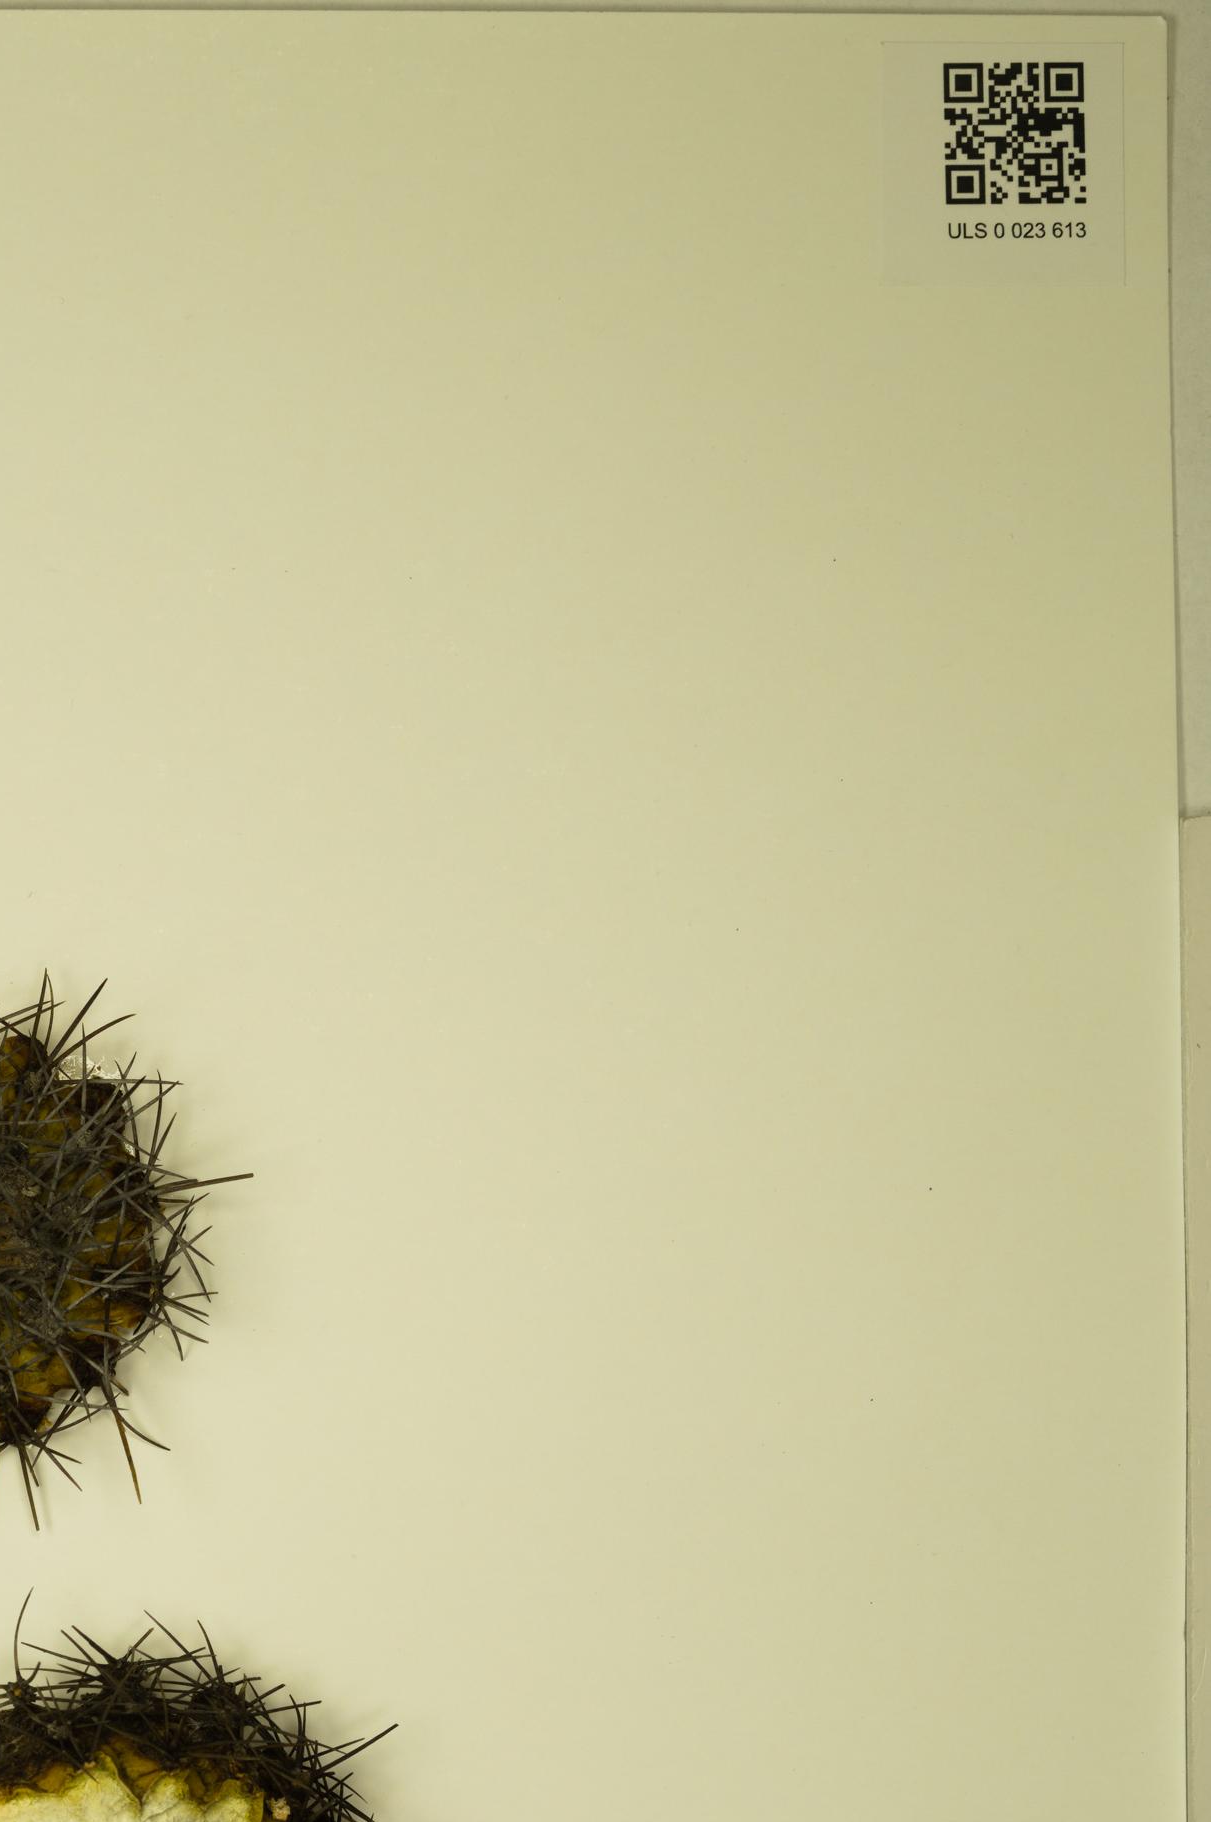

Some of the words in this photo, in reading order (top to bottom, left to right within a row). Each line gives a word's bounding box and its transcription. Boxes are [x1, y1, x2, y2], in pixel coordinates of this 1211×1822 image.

[947, 222, 988, 240] ULS
[993, 222, 1006, 239] 0
[1011, 222, 1047, 240] 023
[1052, 221, 1087, 239] 613
